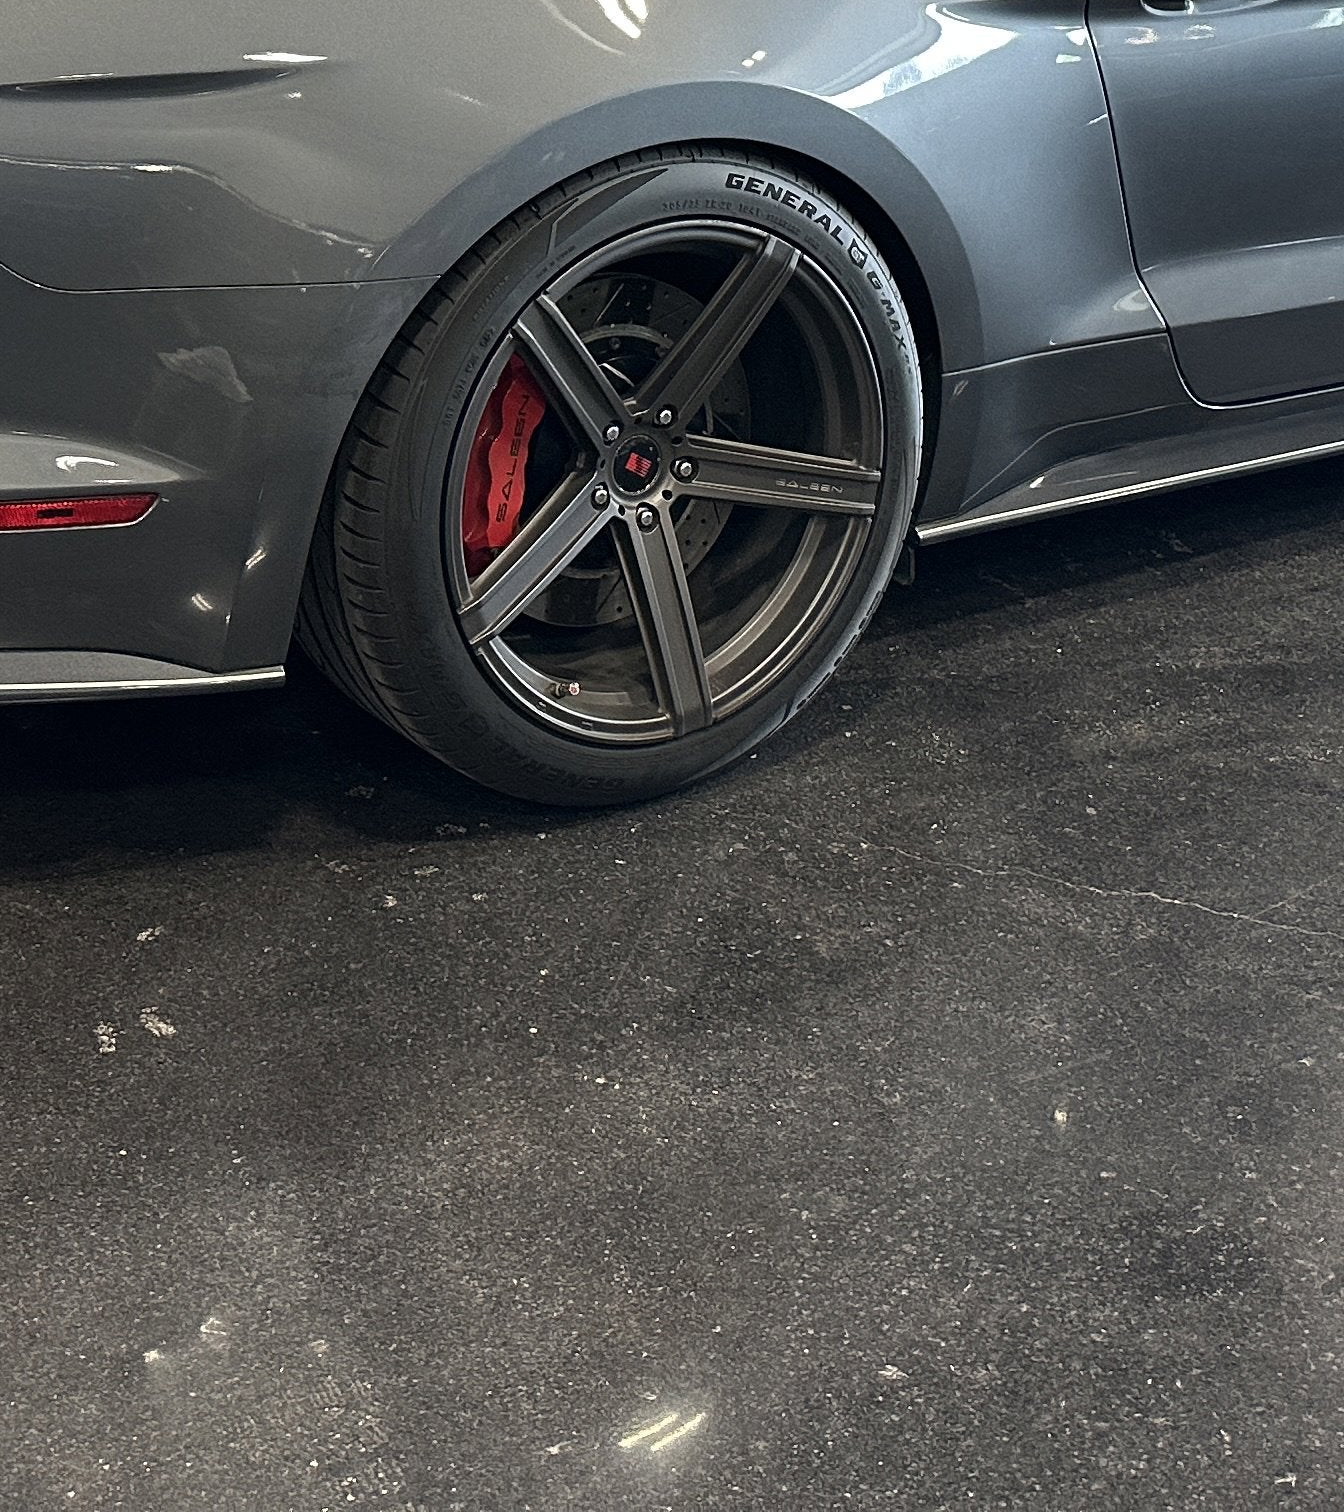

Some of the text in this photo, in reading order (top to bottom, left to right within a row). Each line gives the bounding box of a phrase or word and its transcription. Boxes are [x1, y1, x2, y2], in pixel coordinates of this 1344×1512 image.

[725, 172, 844, 245] GENERAL
[496, 394, 531, 524] SALEEN
[776, 478, 844, 493] SALEEN
